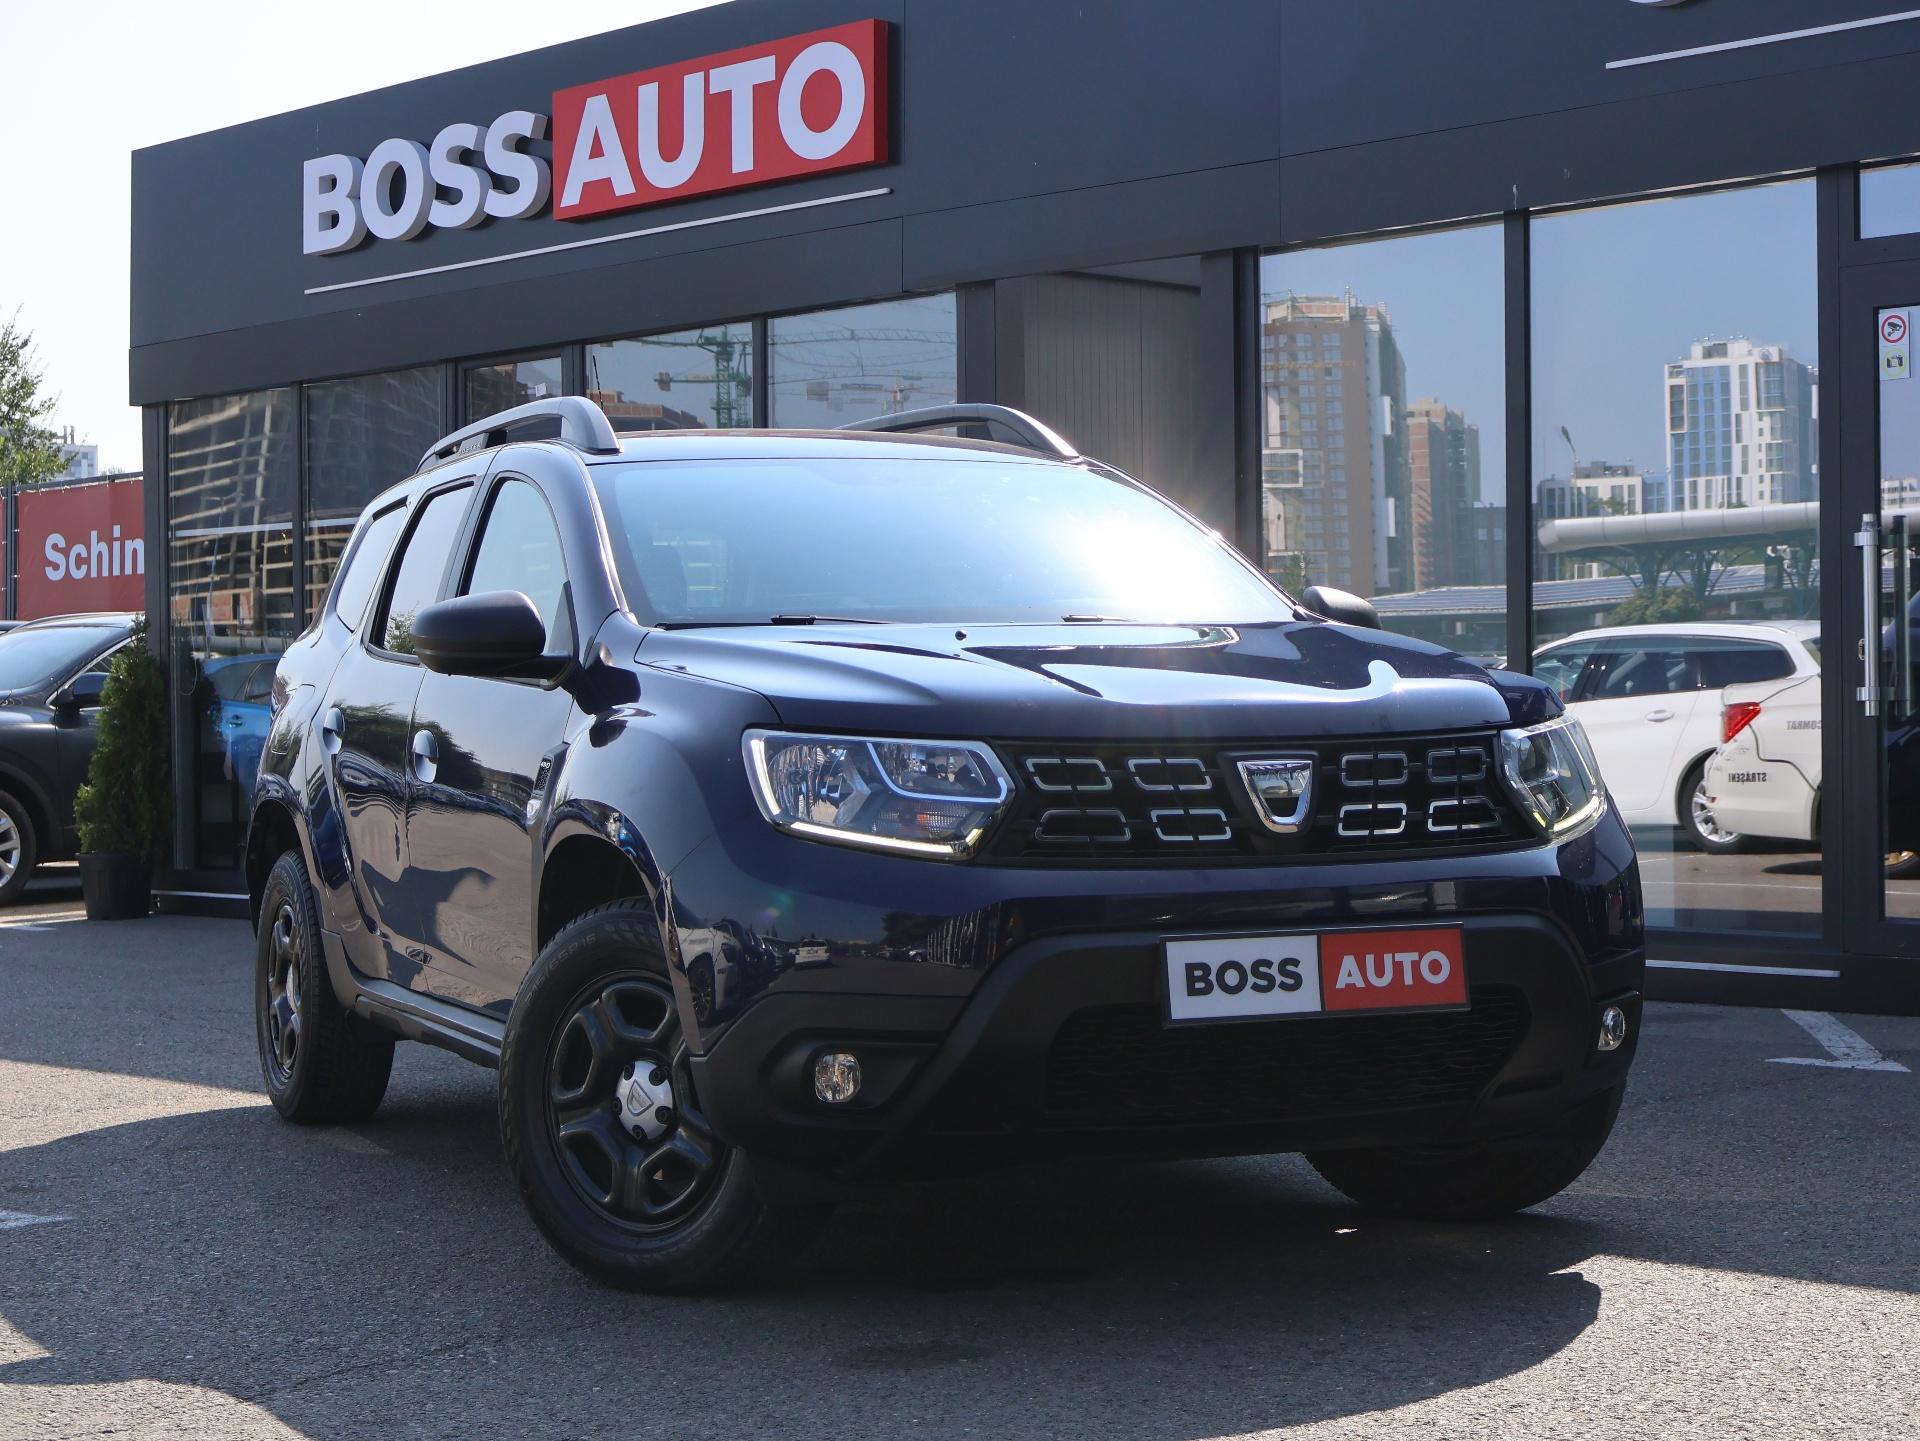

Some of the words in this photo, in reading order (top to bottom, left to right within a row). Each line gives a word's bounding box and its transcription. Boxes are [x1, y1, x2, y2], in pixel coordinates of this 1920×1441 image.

[303, 110, 552, 254] BOSS
[559, 41, 866, 207] AUTO
[45, 525, 144, 581] Schin
[1184, 957, 1303, 997] BOSS
[1335, 950, 1451, 989] AUTO
